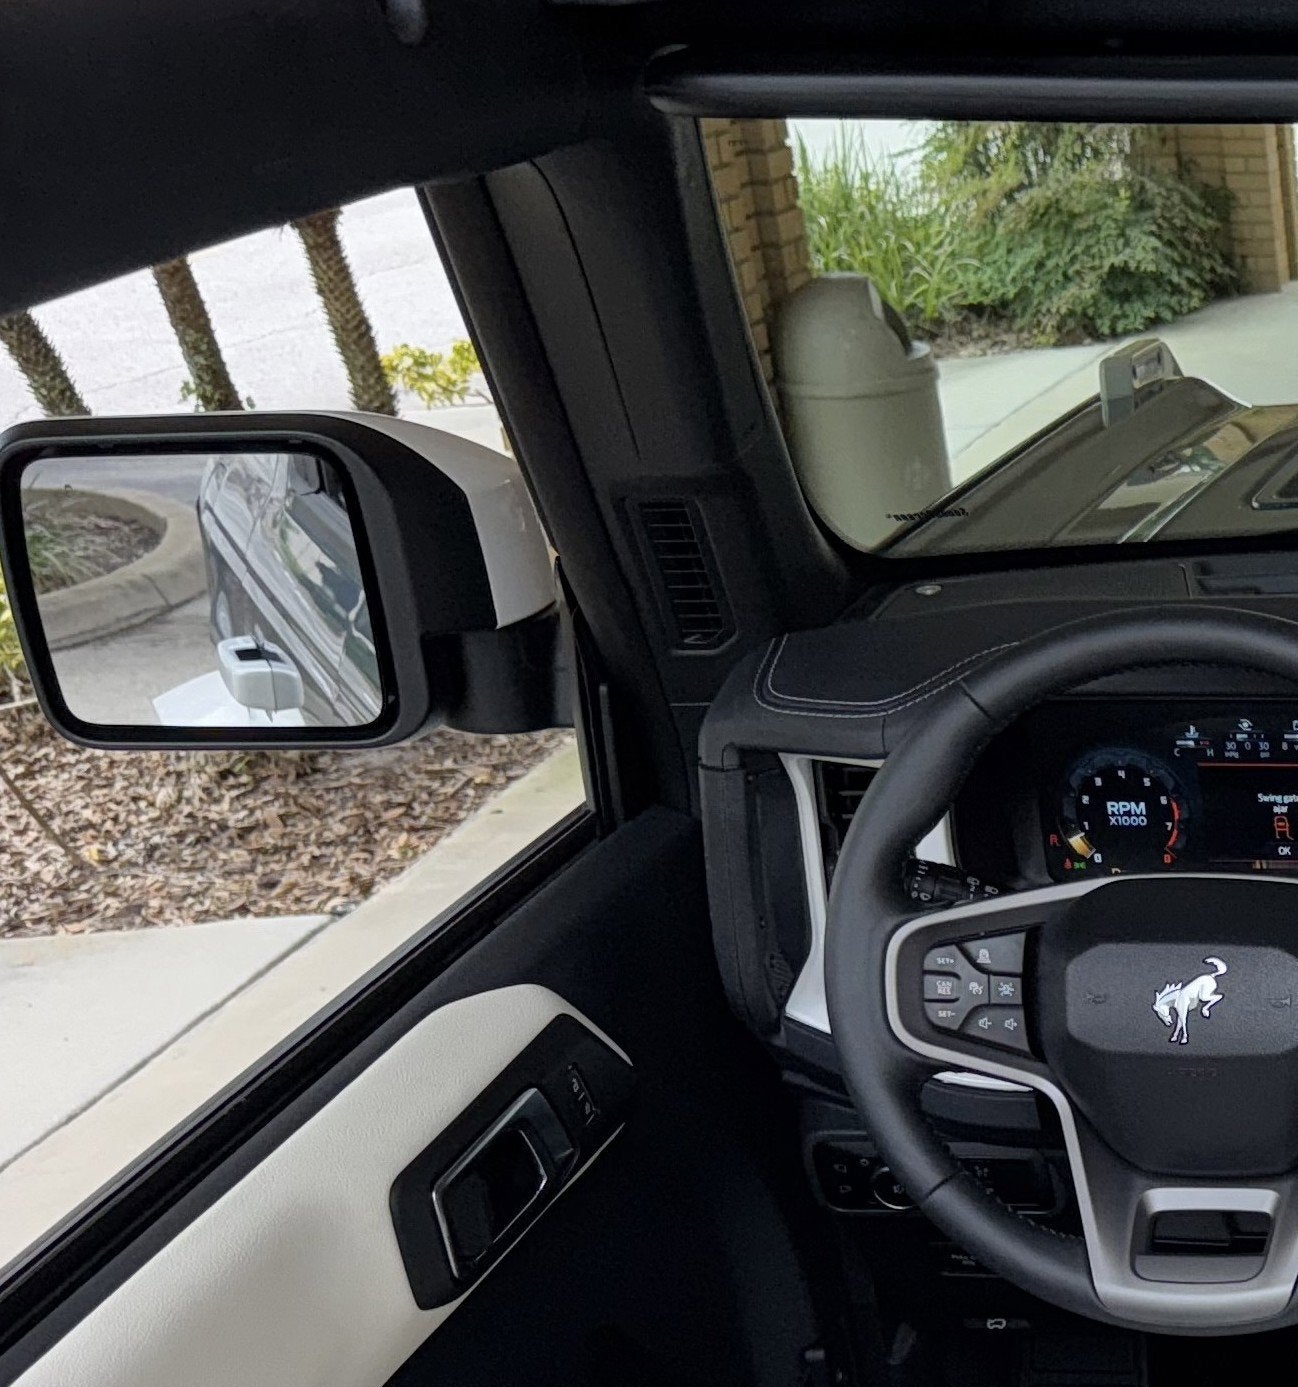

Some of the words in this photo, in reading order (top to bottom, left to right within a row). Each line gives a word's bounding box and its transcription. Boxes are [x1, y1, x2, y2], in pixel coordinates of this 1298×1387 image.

[1117, 770, 1126, 778] 4
[1106, 801, 1146, 815] RPM
[1165, 822, 1172, 831] 7
[1278, 846, 1291, 855] OK
